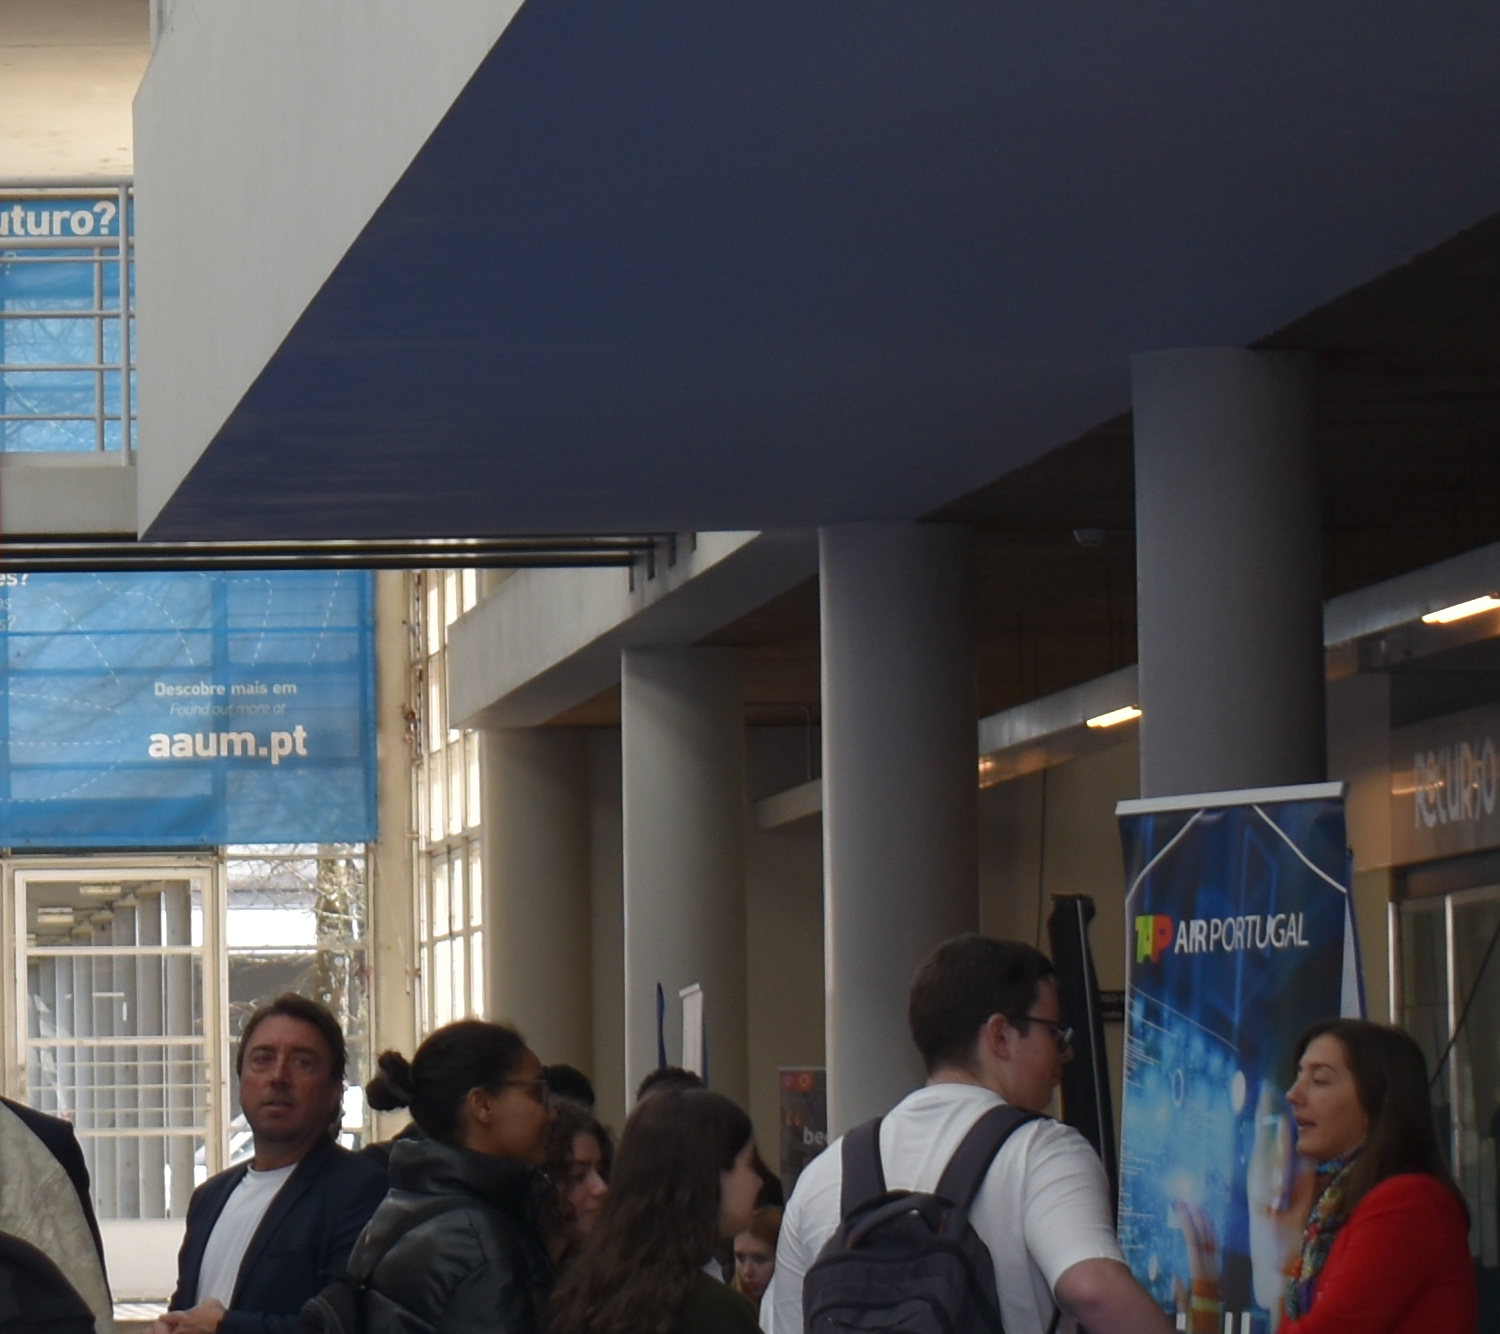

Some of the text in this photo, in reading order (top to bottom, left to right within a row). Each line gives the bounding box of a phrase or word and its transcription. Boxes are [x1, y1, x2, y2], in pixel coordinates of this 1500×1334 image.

[154, 680, 298, 697] Descobre mais em
[148, 724, 308, 766] aaum.pt
[1134, 913, 1175, 964] TAP
